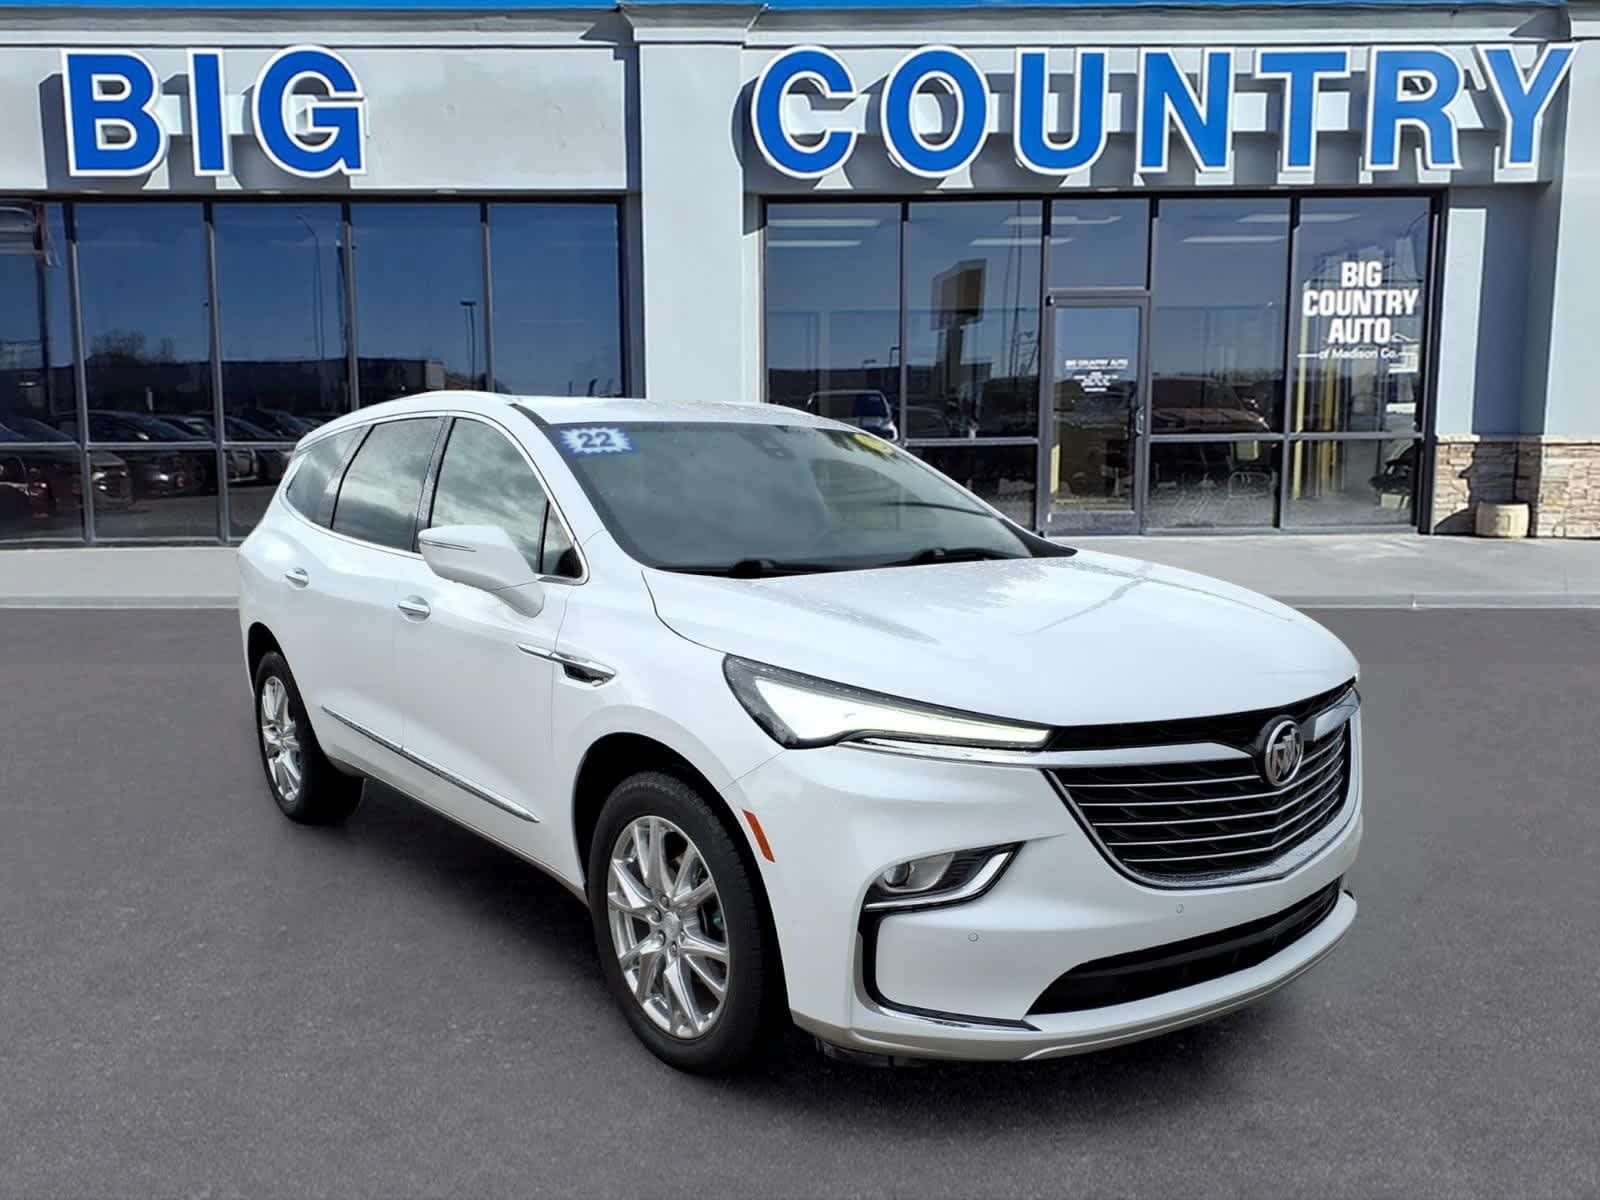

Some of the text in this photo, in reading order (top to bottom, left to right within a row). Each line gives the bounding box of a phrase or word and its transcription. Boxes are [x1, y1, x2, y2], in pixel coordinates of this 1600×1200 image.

[61, 44, 1575, 180] BIG COUNTRY
[1341, 260, 1382, 288] BIG
[1303, 289, 1419, 316] COUNTRY
[1328, 317, 1392, 345] AUTO
[577, 431, 616, 449] 22
